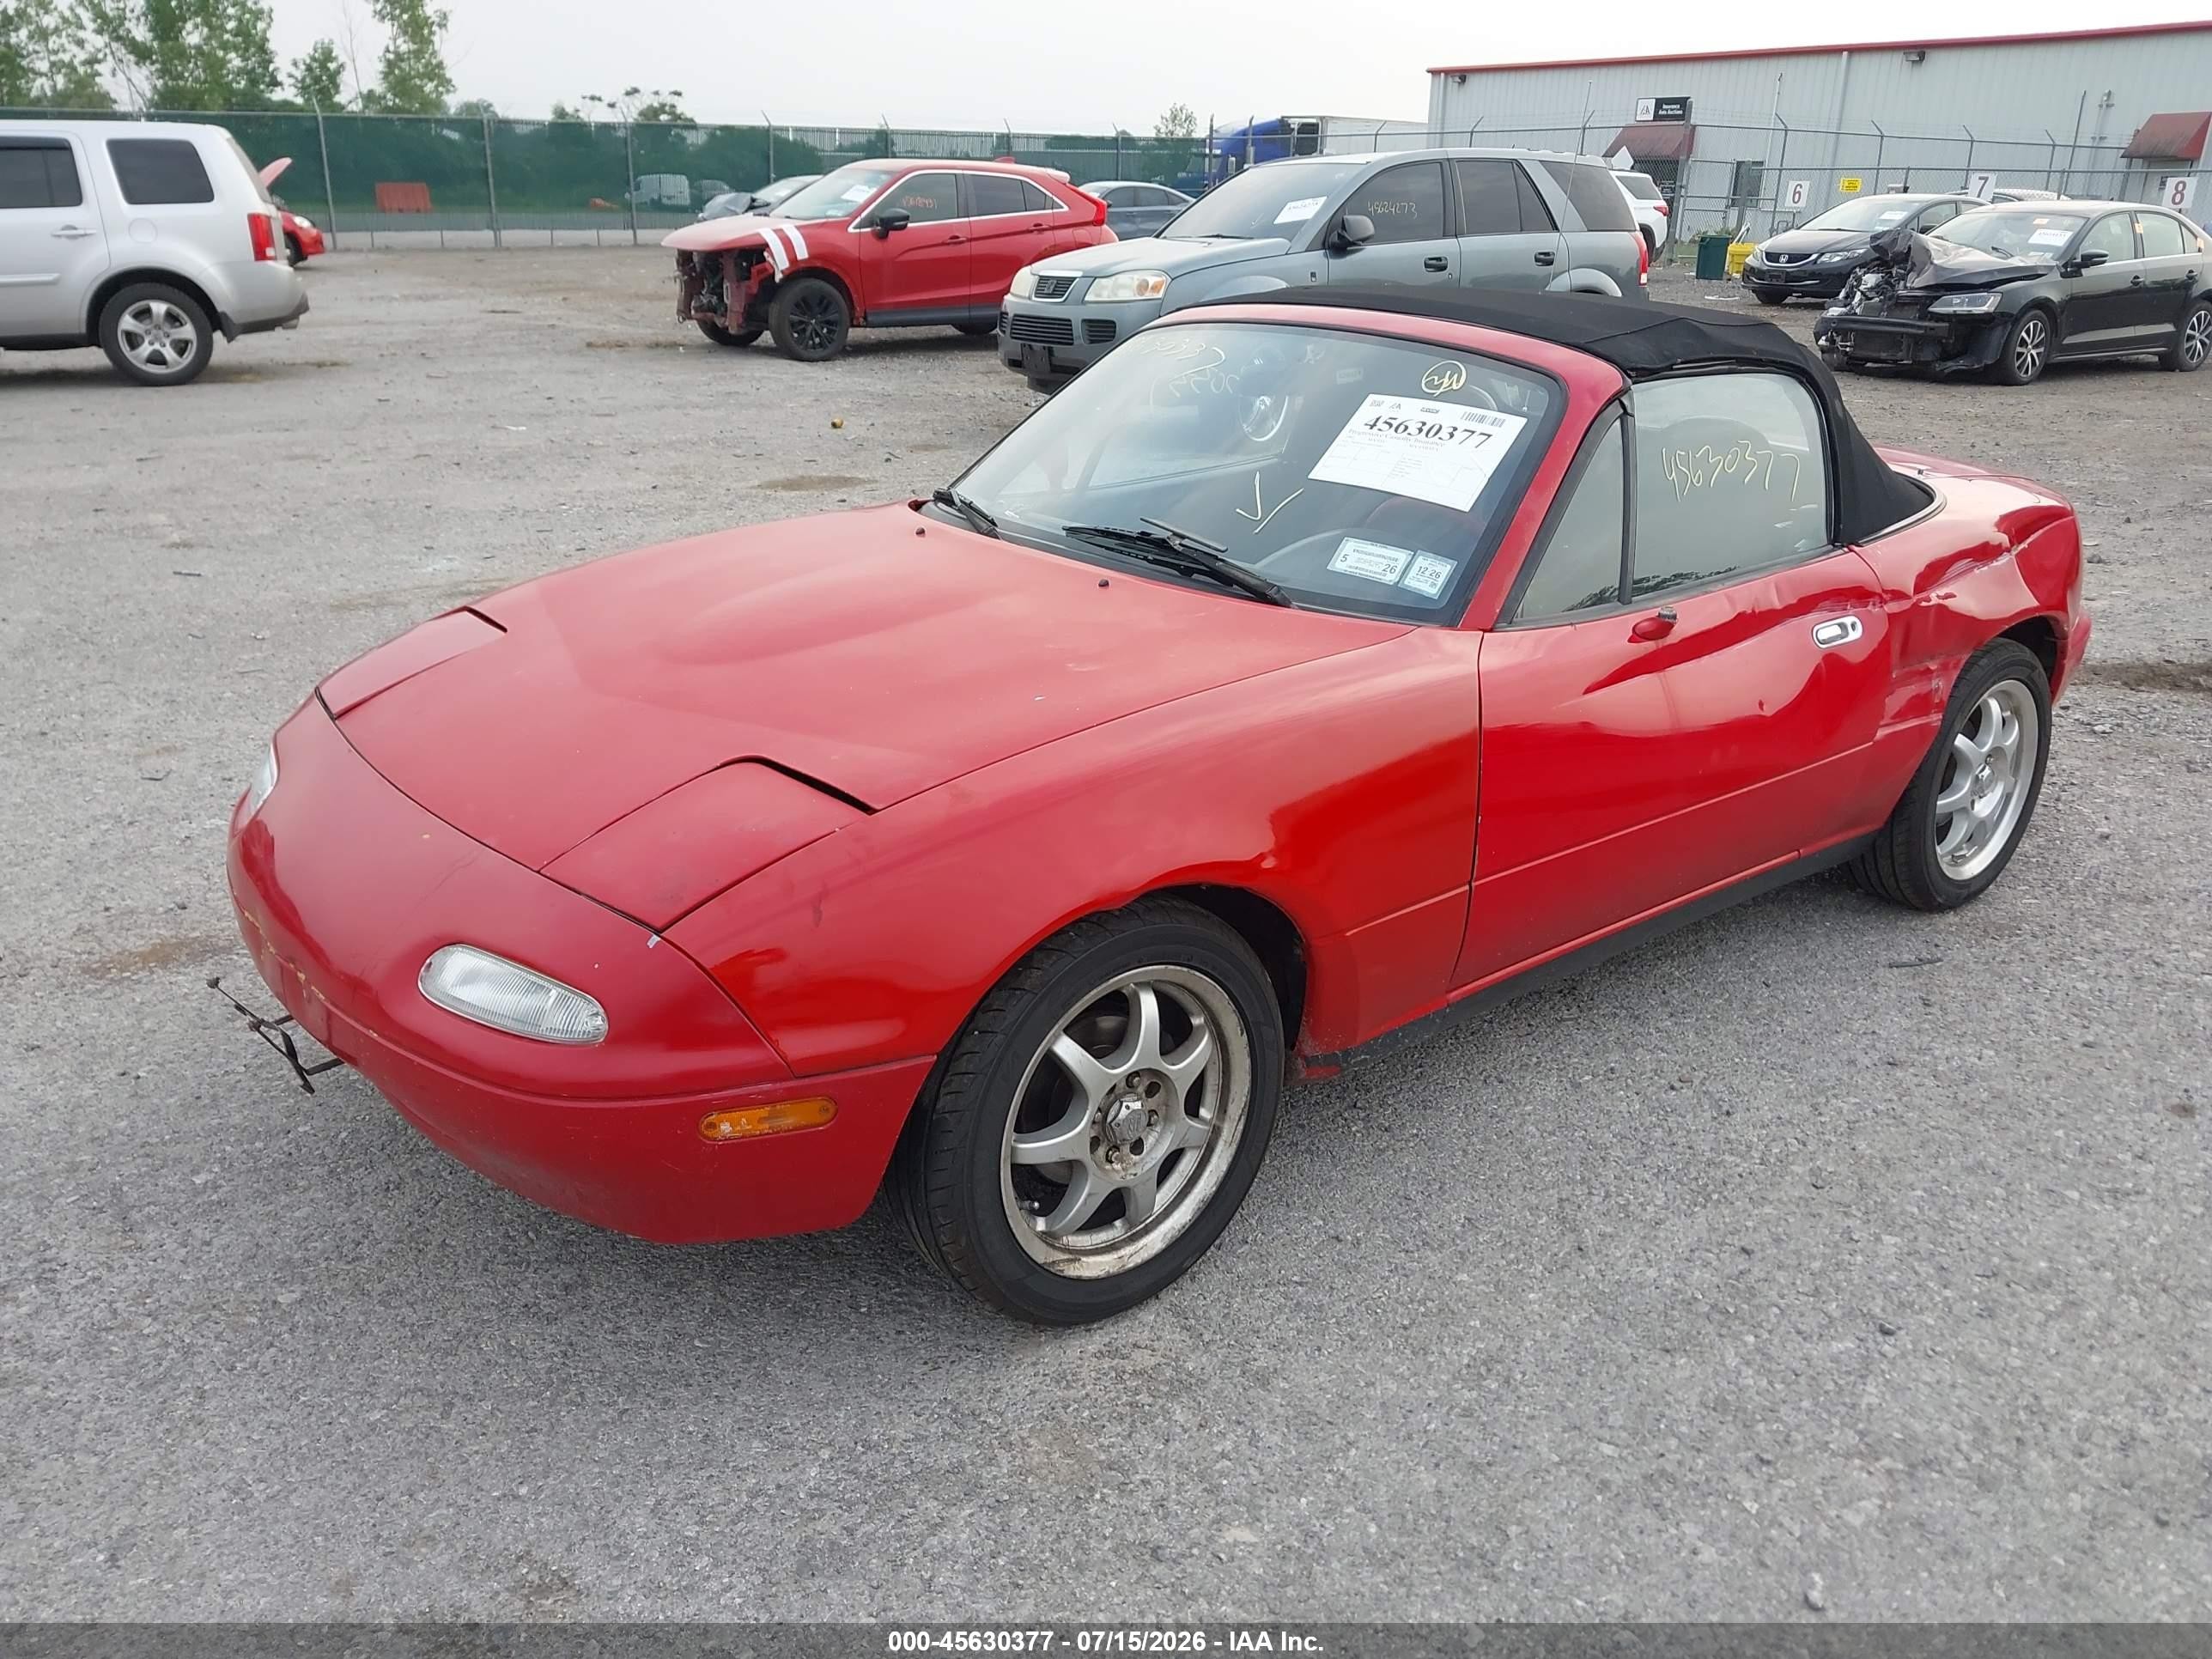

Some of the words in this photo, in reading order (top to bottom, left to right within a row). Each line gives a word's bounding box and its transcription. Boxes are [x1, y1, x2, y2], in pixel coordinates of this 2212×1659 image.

[1792, 183, 1802, 204] 6
[1977, 175, 1989, 198] 7
[2171, 179, 2186, 205] 8
[1364, 415, 1493, 448] 45630377
[1662, 440, 1801, 501] 45630377
[1340, 553, 1350, 562] 5
[1382, 563, 1398, 574] 26
